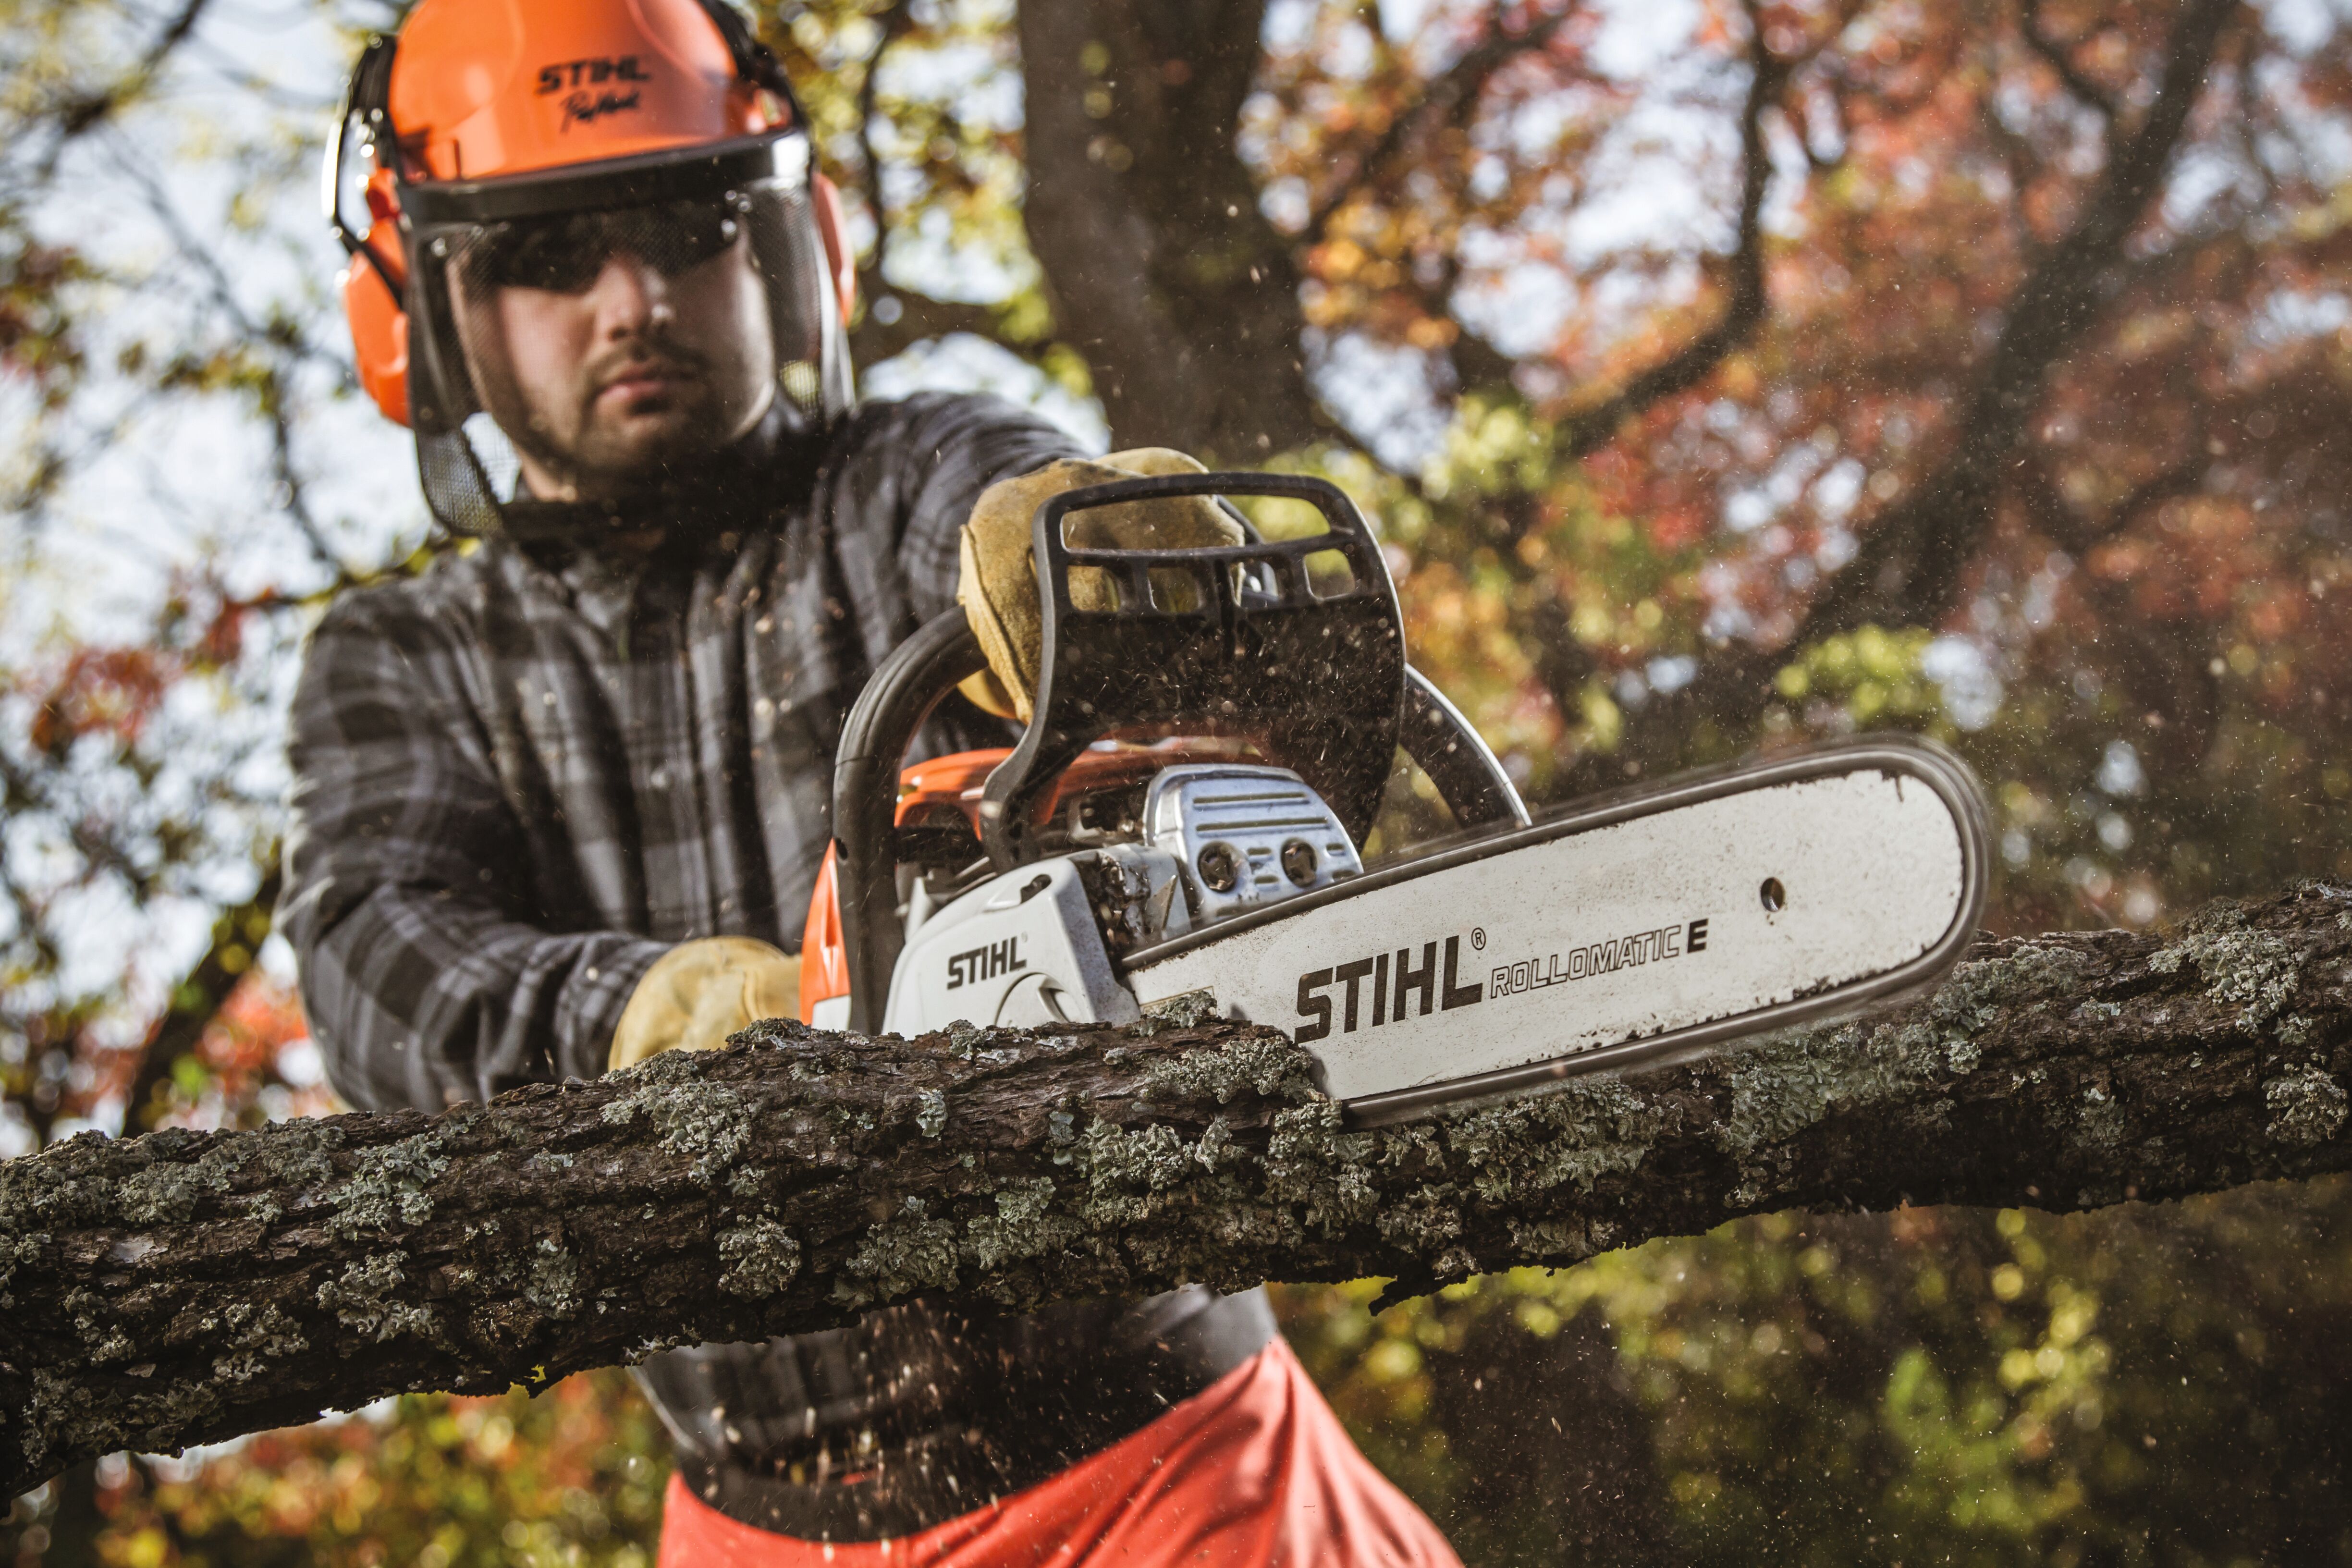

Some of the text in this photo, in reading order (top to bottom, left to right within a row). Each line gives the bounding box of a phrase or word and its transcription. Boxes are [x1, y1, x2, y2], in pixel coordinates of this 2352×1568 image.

[946, 935, 1027, 990] STIHL
[1490, 924, 1681, 999] ROLLOMATIC
[1687, 918, 1709, 954] E
